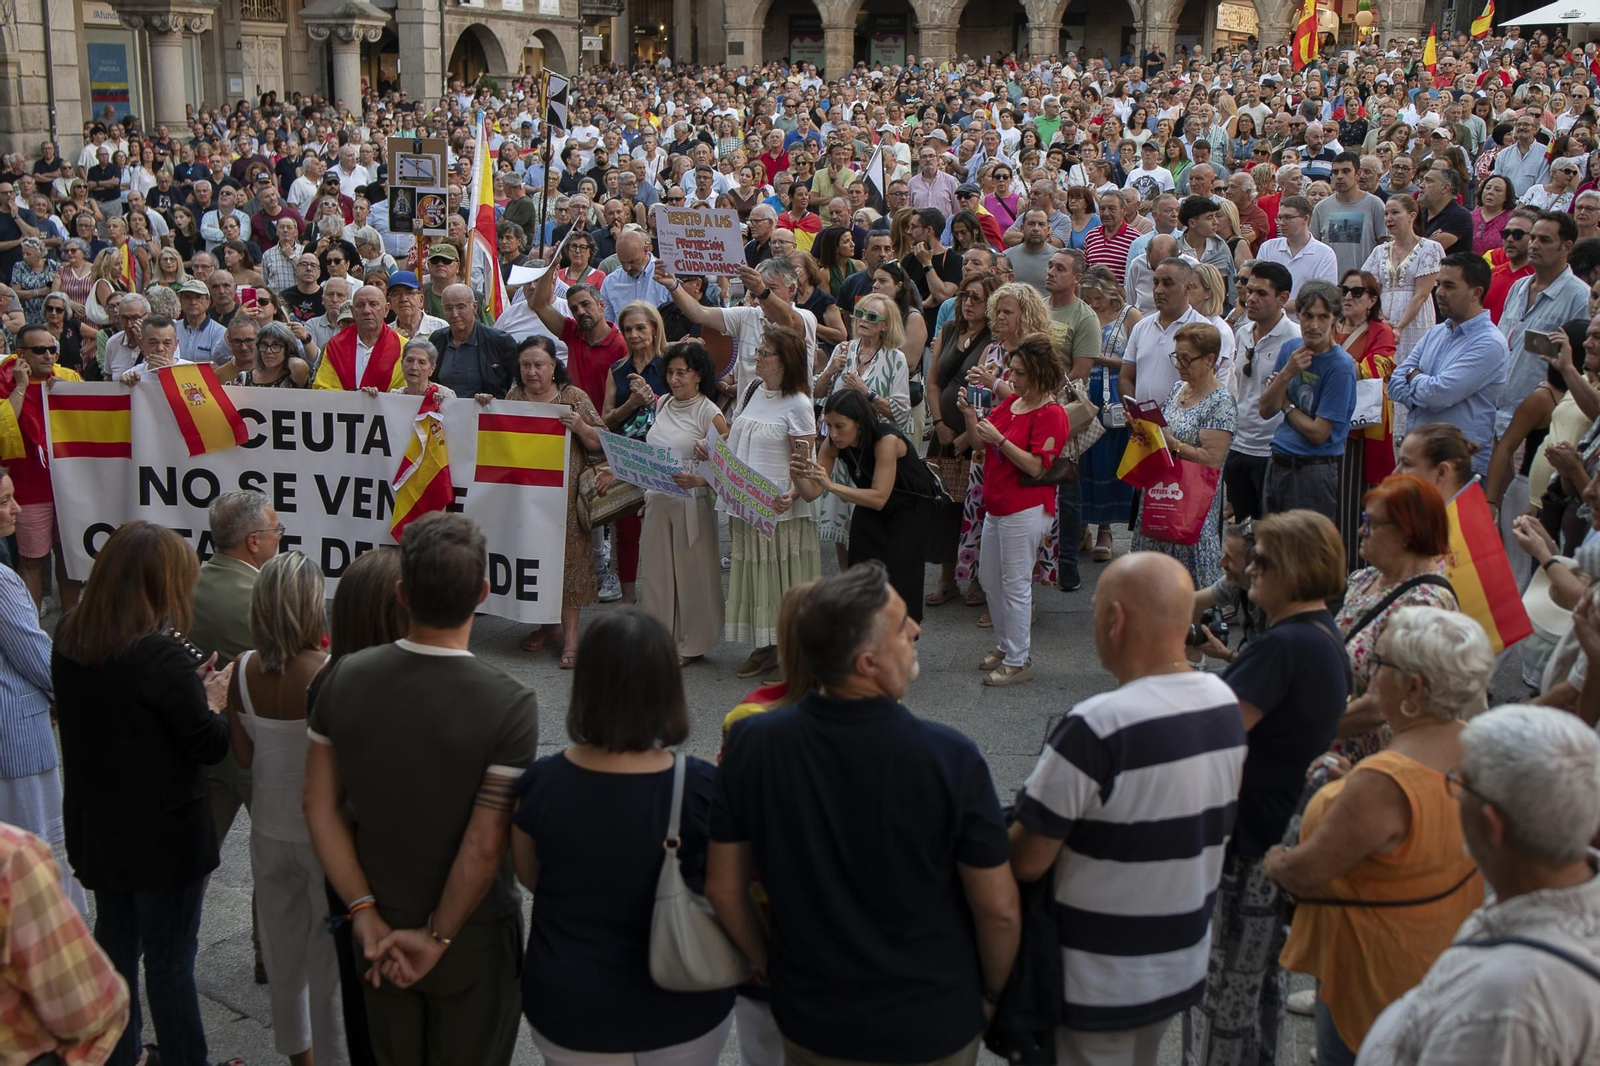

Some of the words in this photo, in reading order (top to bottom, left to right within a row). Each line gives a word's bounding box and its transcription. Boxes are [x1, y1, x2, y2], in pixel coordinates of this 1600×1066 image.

[704, 214, 713, 227] A
[714, 214, 732, 229] LAS
[683, 250, 704, 260] PARA
[708, 252, 723, 262] LOS
[237, 408, 392, 457] CEUTA
[726, 466, 744, 489] LAS
[138, 466, 221, 508] NO
[239, 470, 297, 513] SE
[314, 474, 468, 521] VENE
[728, 484, 775, 520] NUESTRAS
